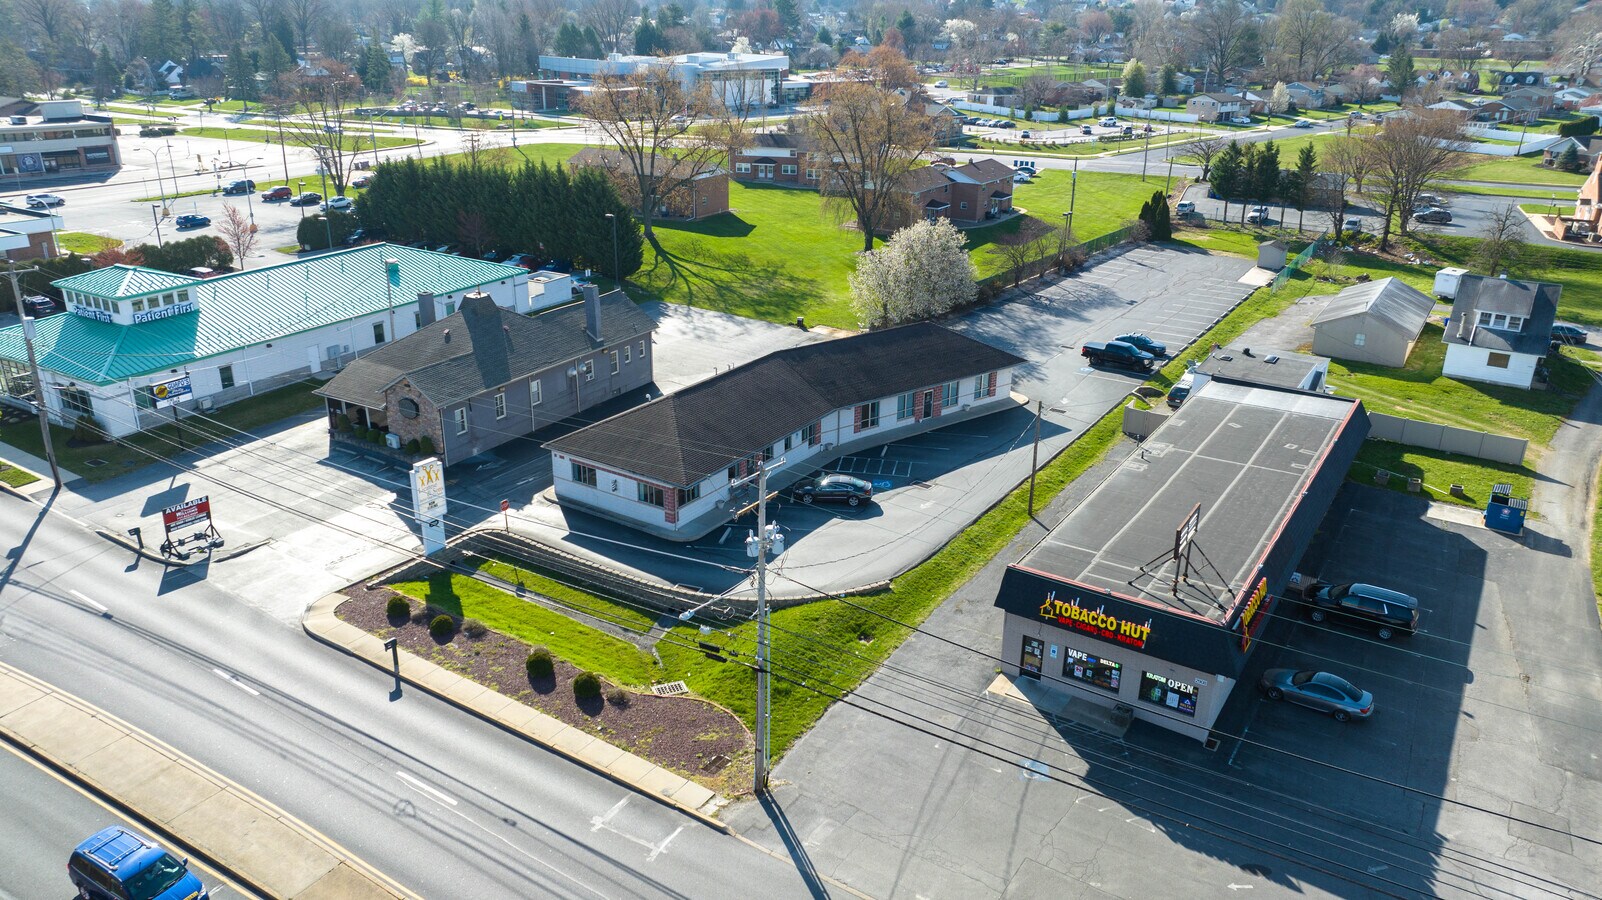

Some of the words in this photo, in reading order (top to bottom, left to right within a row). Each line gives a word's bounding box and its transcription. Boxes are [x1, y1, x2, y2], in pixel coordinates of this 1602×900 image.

[73, 305, 96, 319] Patient
[134, 308, 171, 324] Patient
[174, 302, 194, 315] First
[166, 496, 208, 514] AVAILABLE
[1054, 600, 1117, 631] TOBACCO
[1120, 620, 1151, 641] HUT
[1057, 616, 1073, 627] VAPE
[1075, 621, 1098, 634] CIGARS
[1101, 629, 1114, 639] CBD
[1068, 648, 1088, 662] VAPE
[1100, 658, 1116, 668] DELTA
[1167, 679, 1194, 694] OPEN
